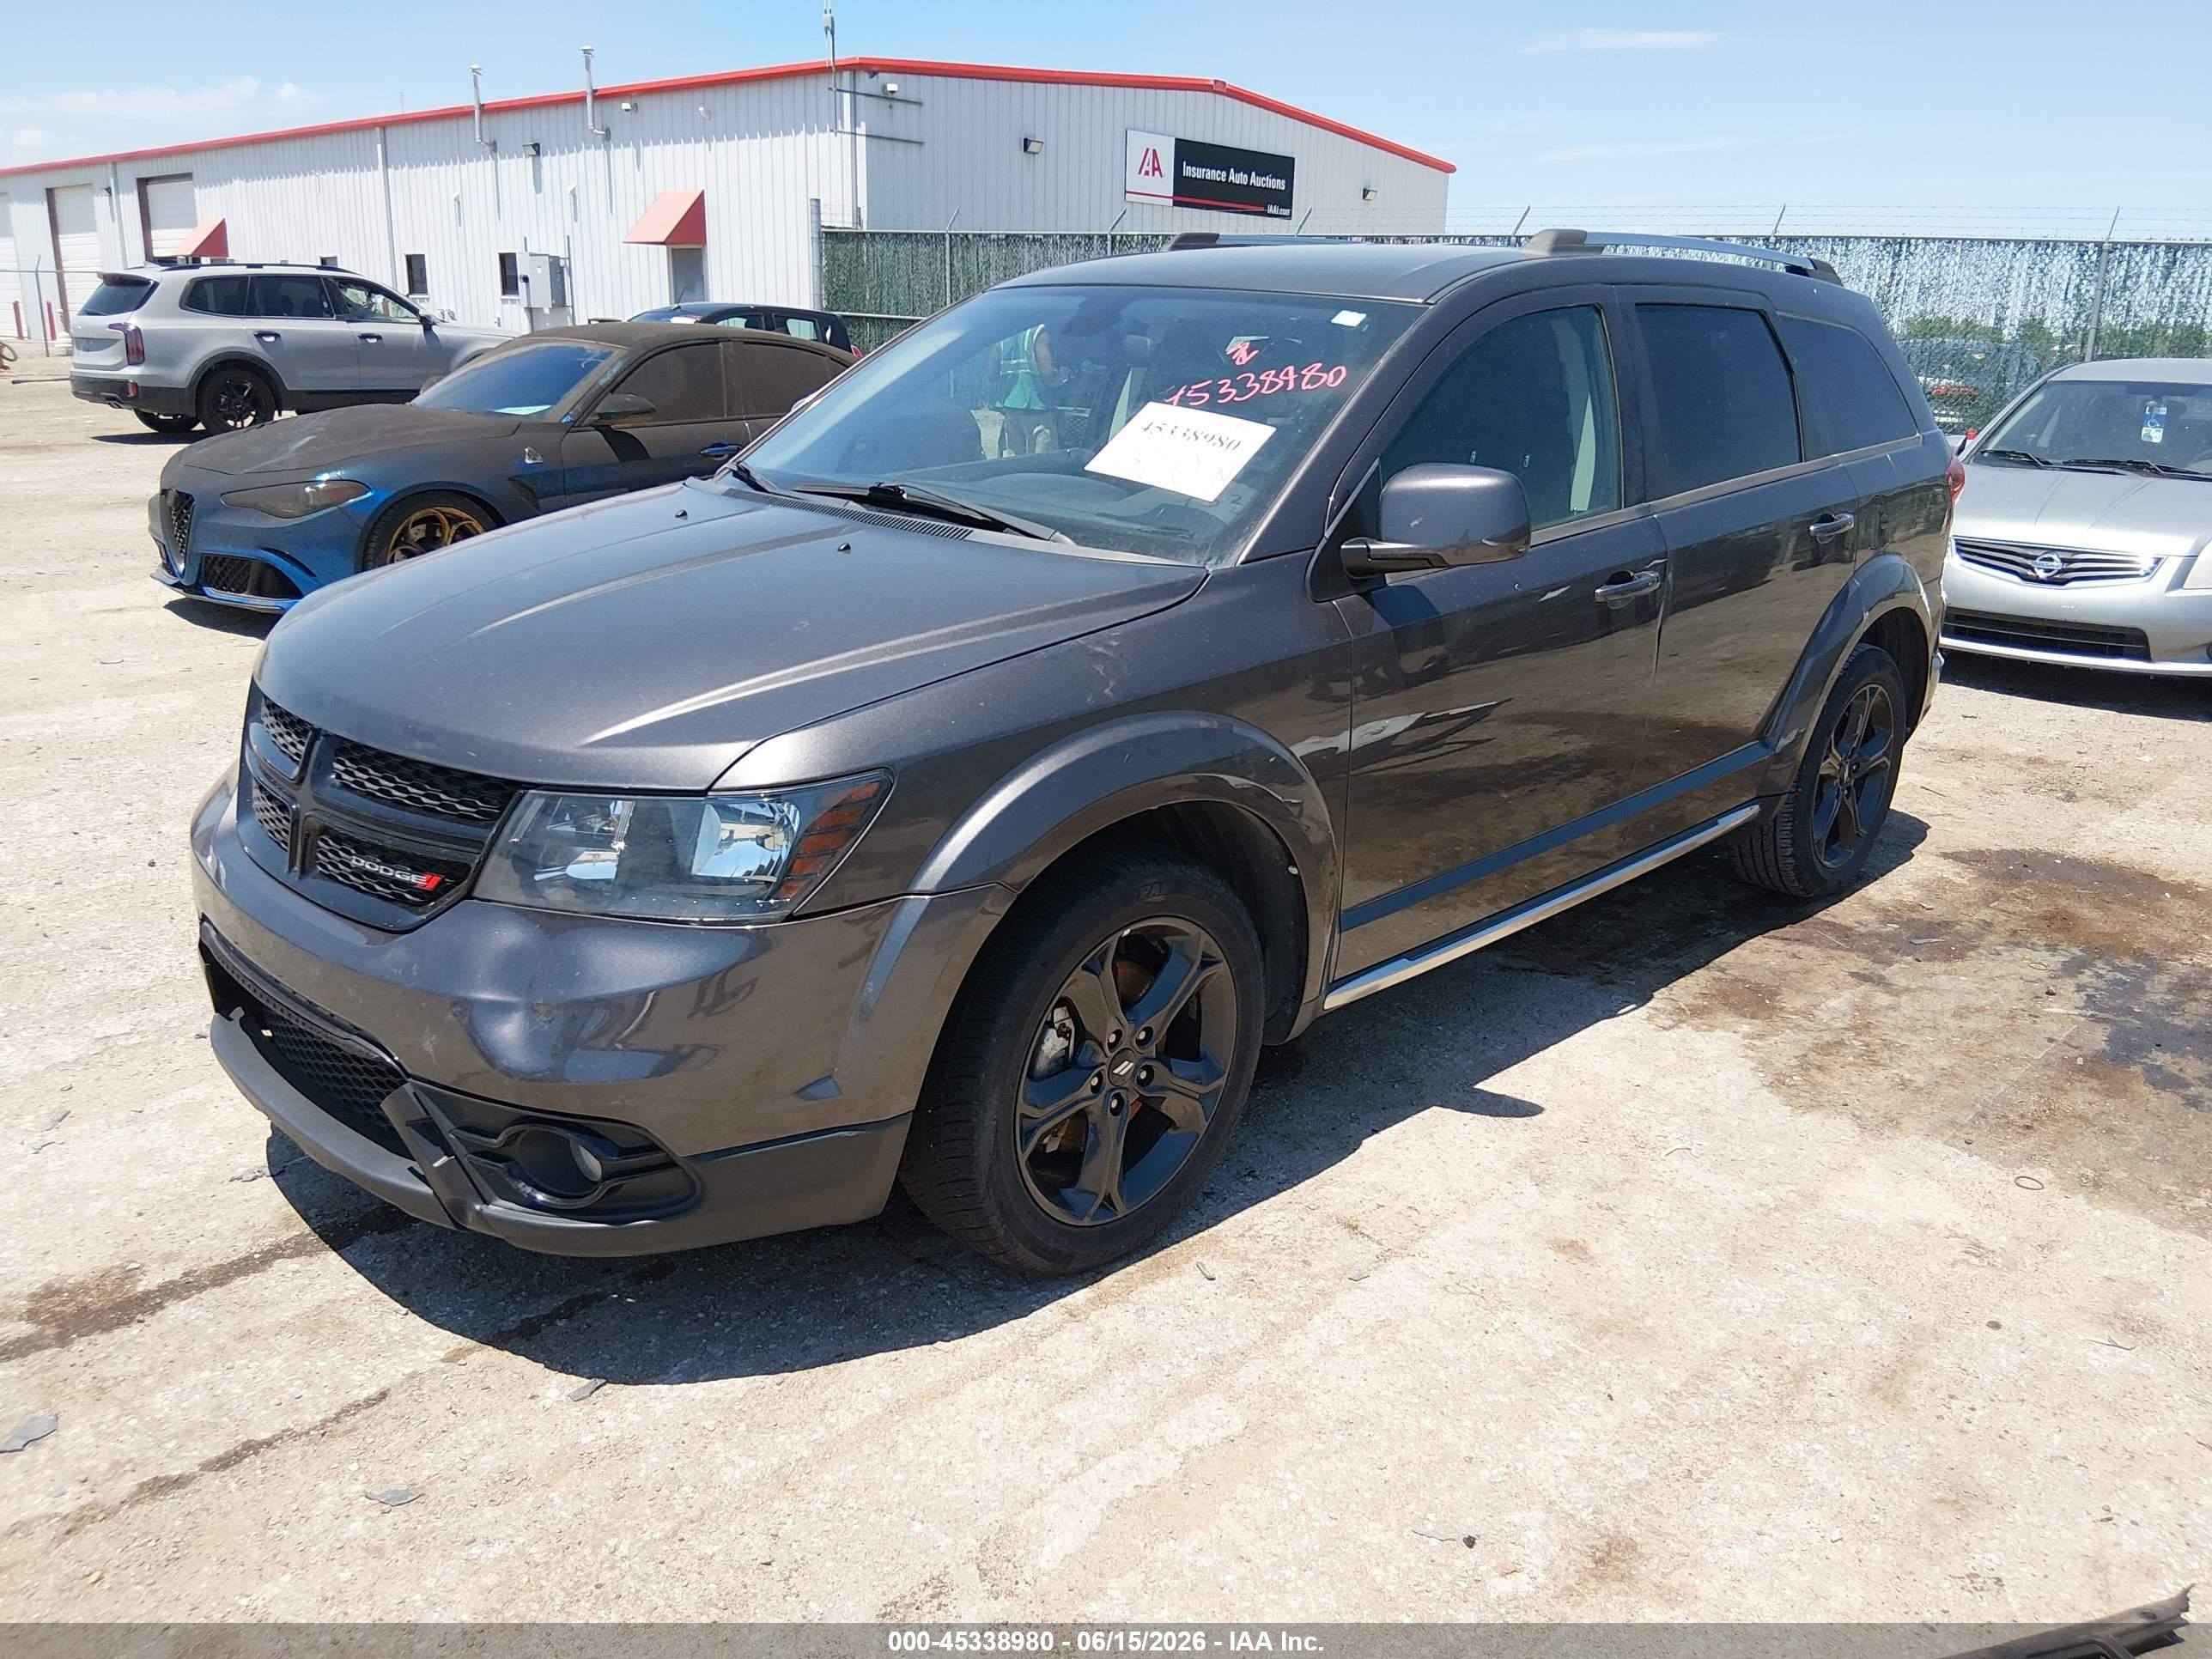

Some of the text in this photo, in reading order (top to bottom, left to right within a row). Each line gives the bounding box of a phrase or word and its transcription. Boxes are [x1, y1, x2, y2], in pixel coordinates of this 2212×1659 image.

[1182, 161, 1286, 191] Insurance Auto Auctions
[350, 855, 428, 886] DODGE
